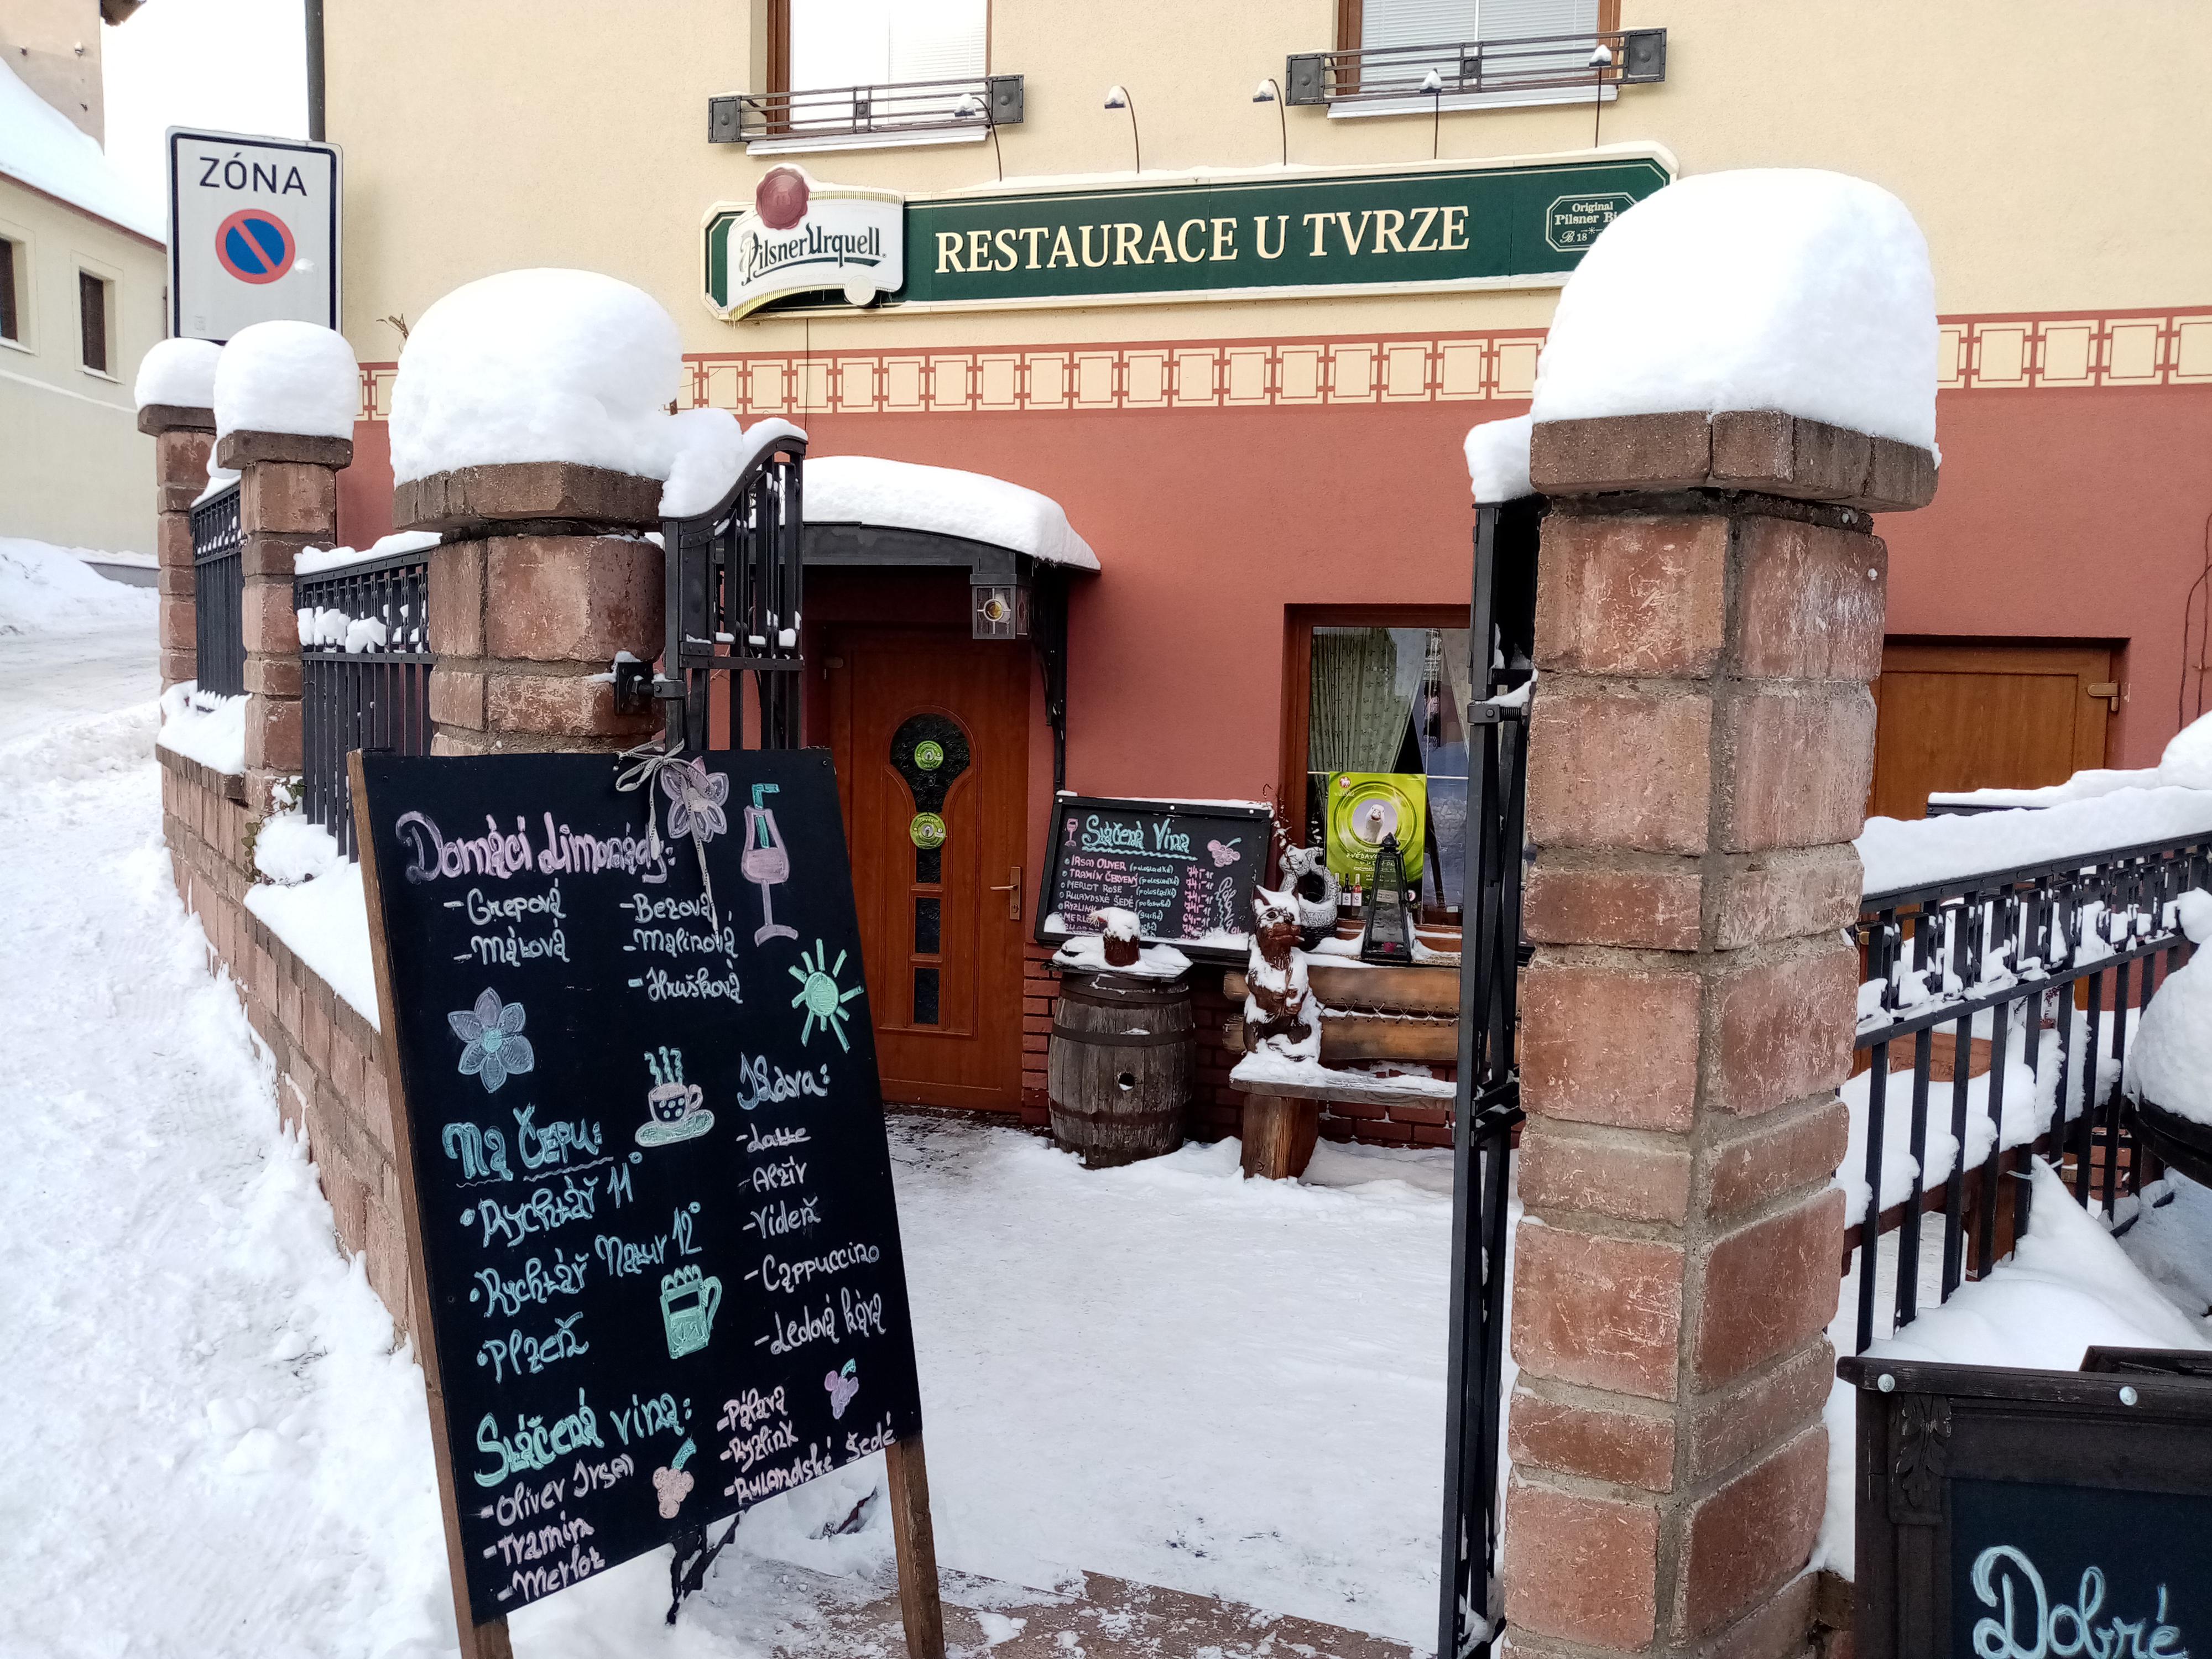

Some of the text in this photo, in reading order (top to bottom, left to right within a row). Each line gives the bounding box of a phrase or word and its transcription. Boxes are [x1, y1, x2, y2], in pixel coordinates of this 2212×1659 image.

[200, 152, 307, 196] ZÓNA
[935, 205, 1470, 274] RESTAURACE U TVRZE
[1554, 214, 1600, 226] Pilsner
[1572, 201, 1614, 214] Original
[739, 222, 881, 286] Pilsner Urquell
[395, 811, 532, 884] Domácí
[1097, 857, 1126, 872] OLIVER
[1067, 880, 1099, 892] MERLOT
[1113, 895, 1134, 908] ŠEDÉ
[478, 1175, 599, 1248] Rychtář
[474, 1247, 590, 1317] Rychtář
[474, 1387, 605, 1488] Stáčená
[1970, 1545, 2191, 1659] Dobré
